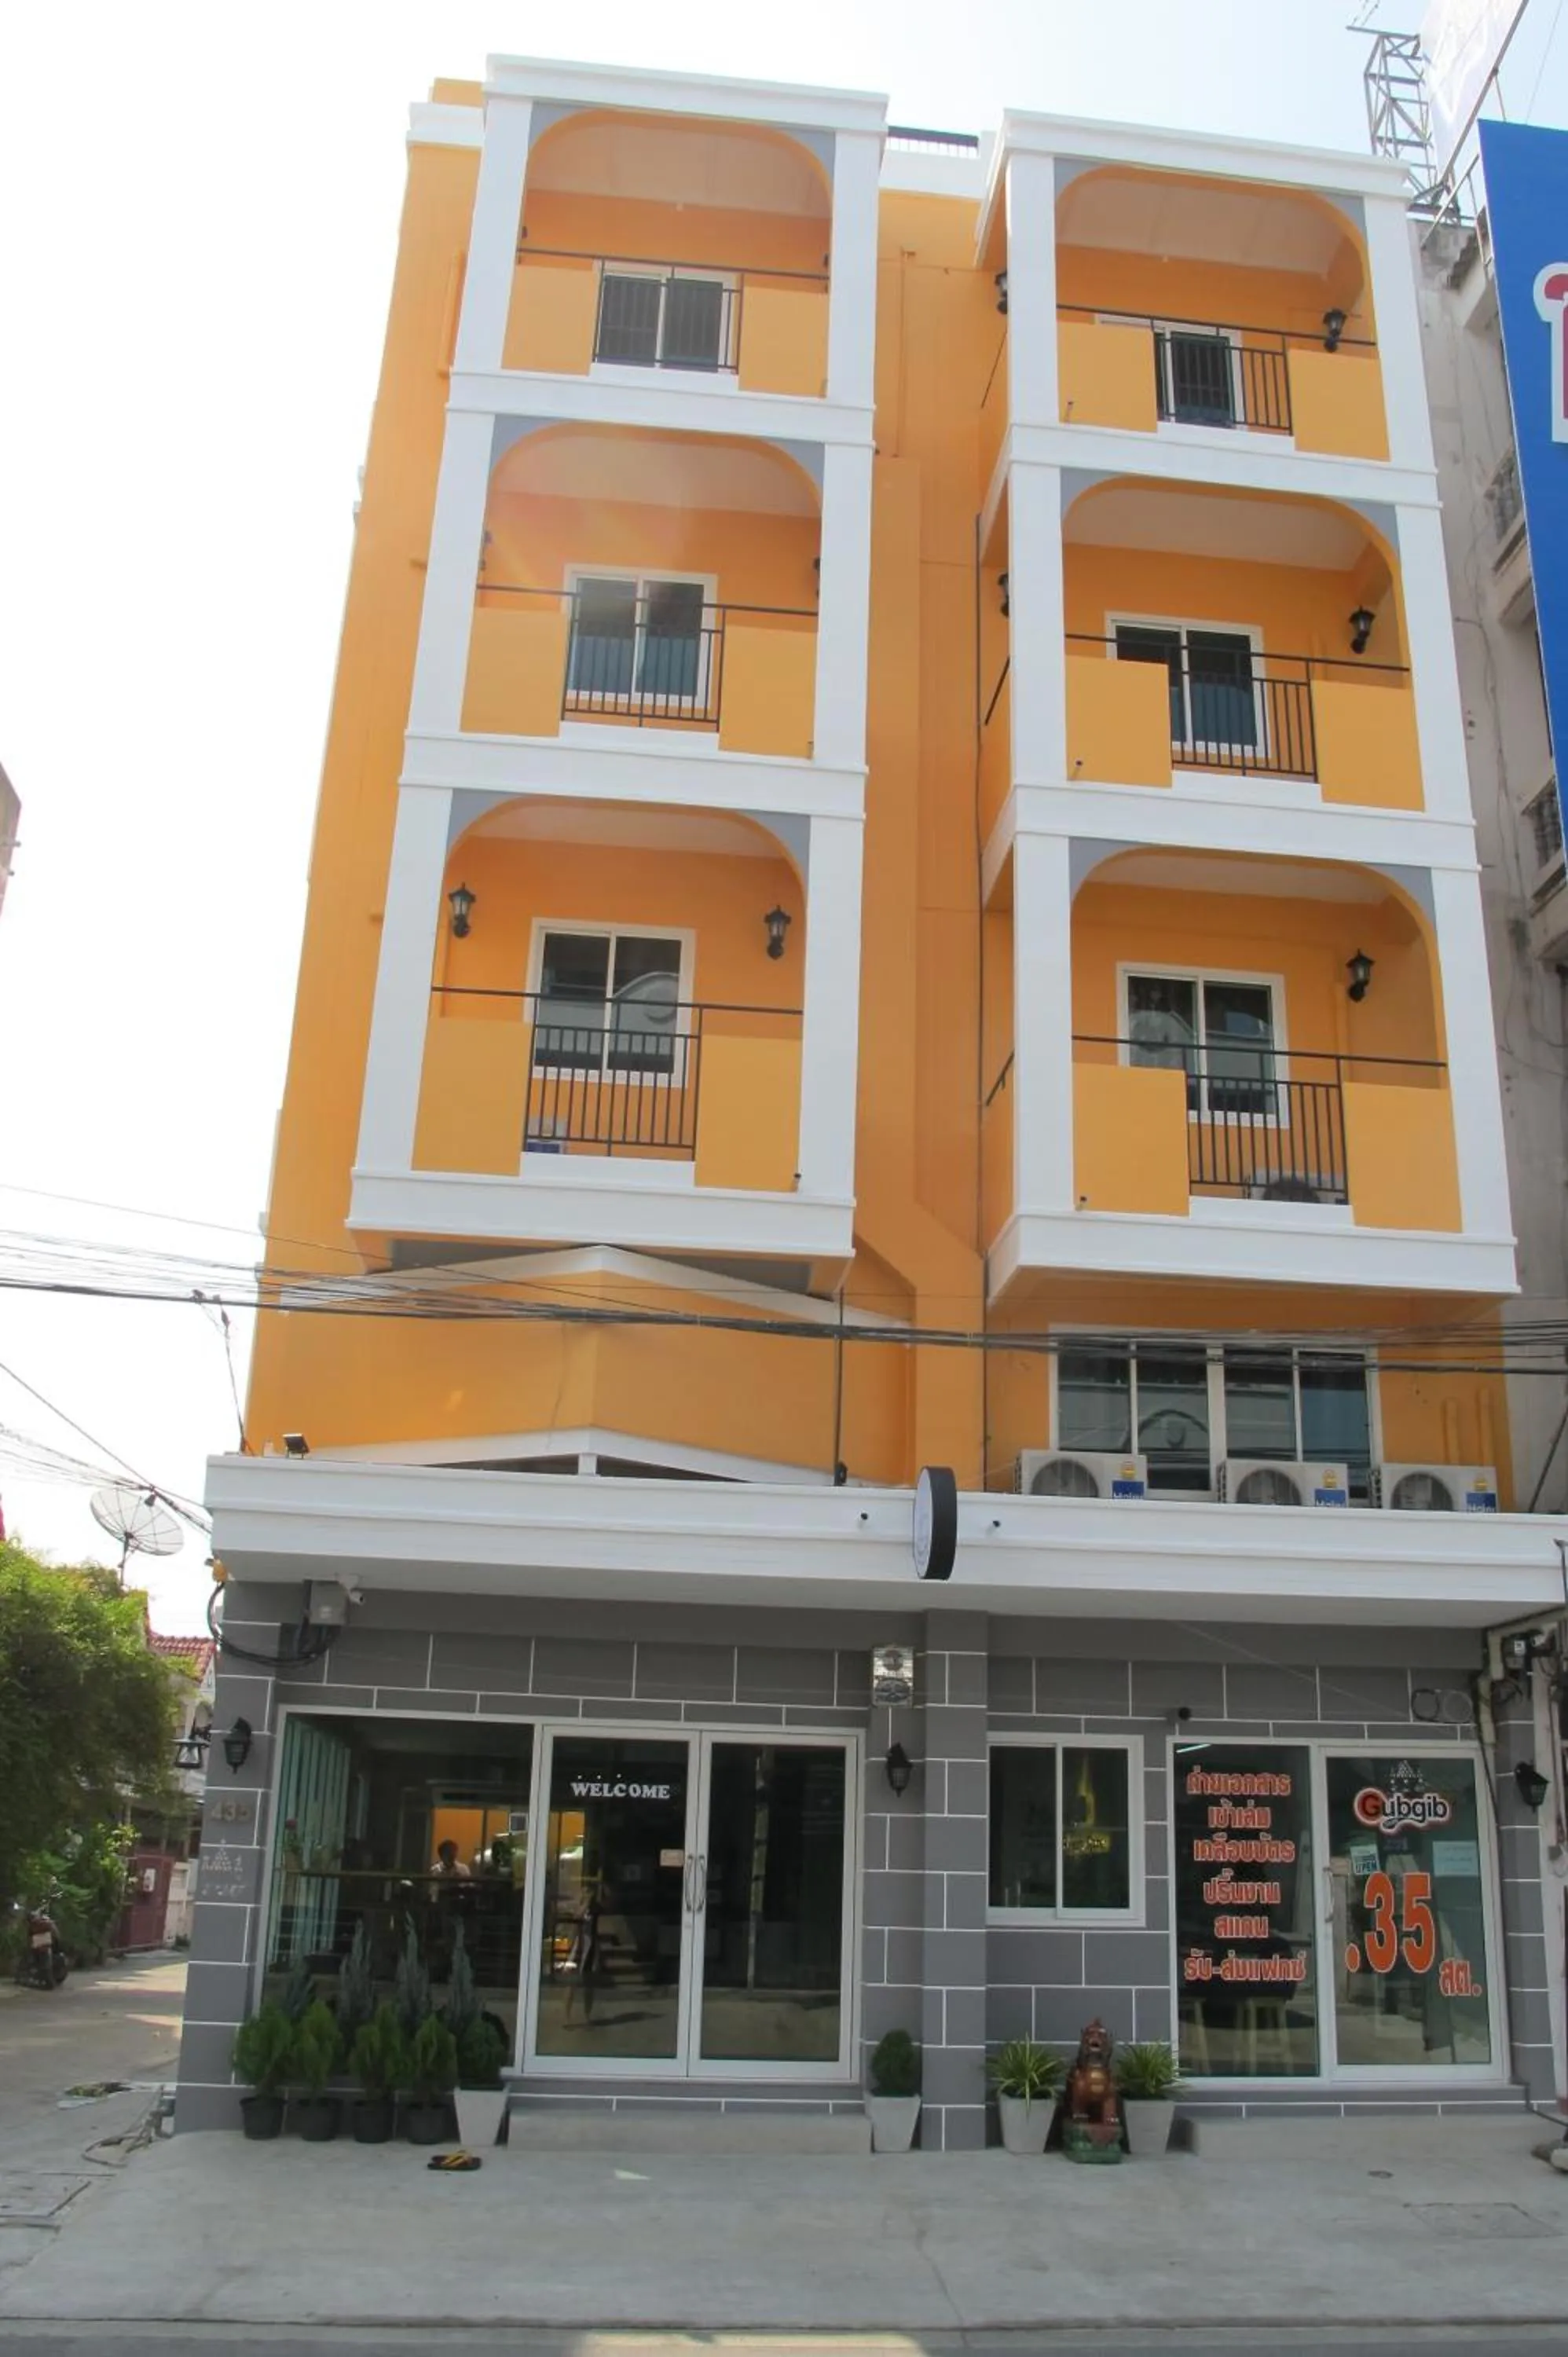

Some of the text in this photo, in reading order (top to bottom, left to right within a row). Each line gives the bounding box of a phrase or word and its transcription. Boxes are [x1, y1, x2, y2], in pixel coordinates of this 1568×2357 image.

[571, 1782, 670, 1799] WELCOME
[1186, 1765, 1291, 1795] ถ่ายเอกสาร
[1208, 1798, 1271, 1828] เข้าเล่ม
[1356, 1788, 1449, 1831] Gubgib
[1193, 1831, 1295, 1863] เคลือบบัตร
[1214, 1915, 1269, 1938] สแกน
